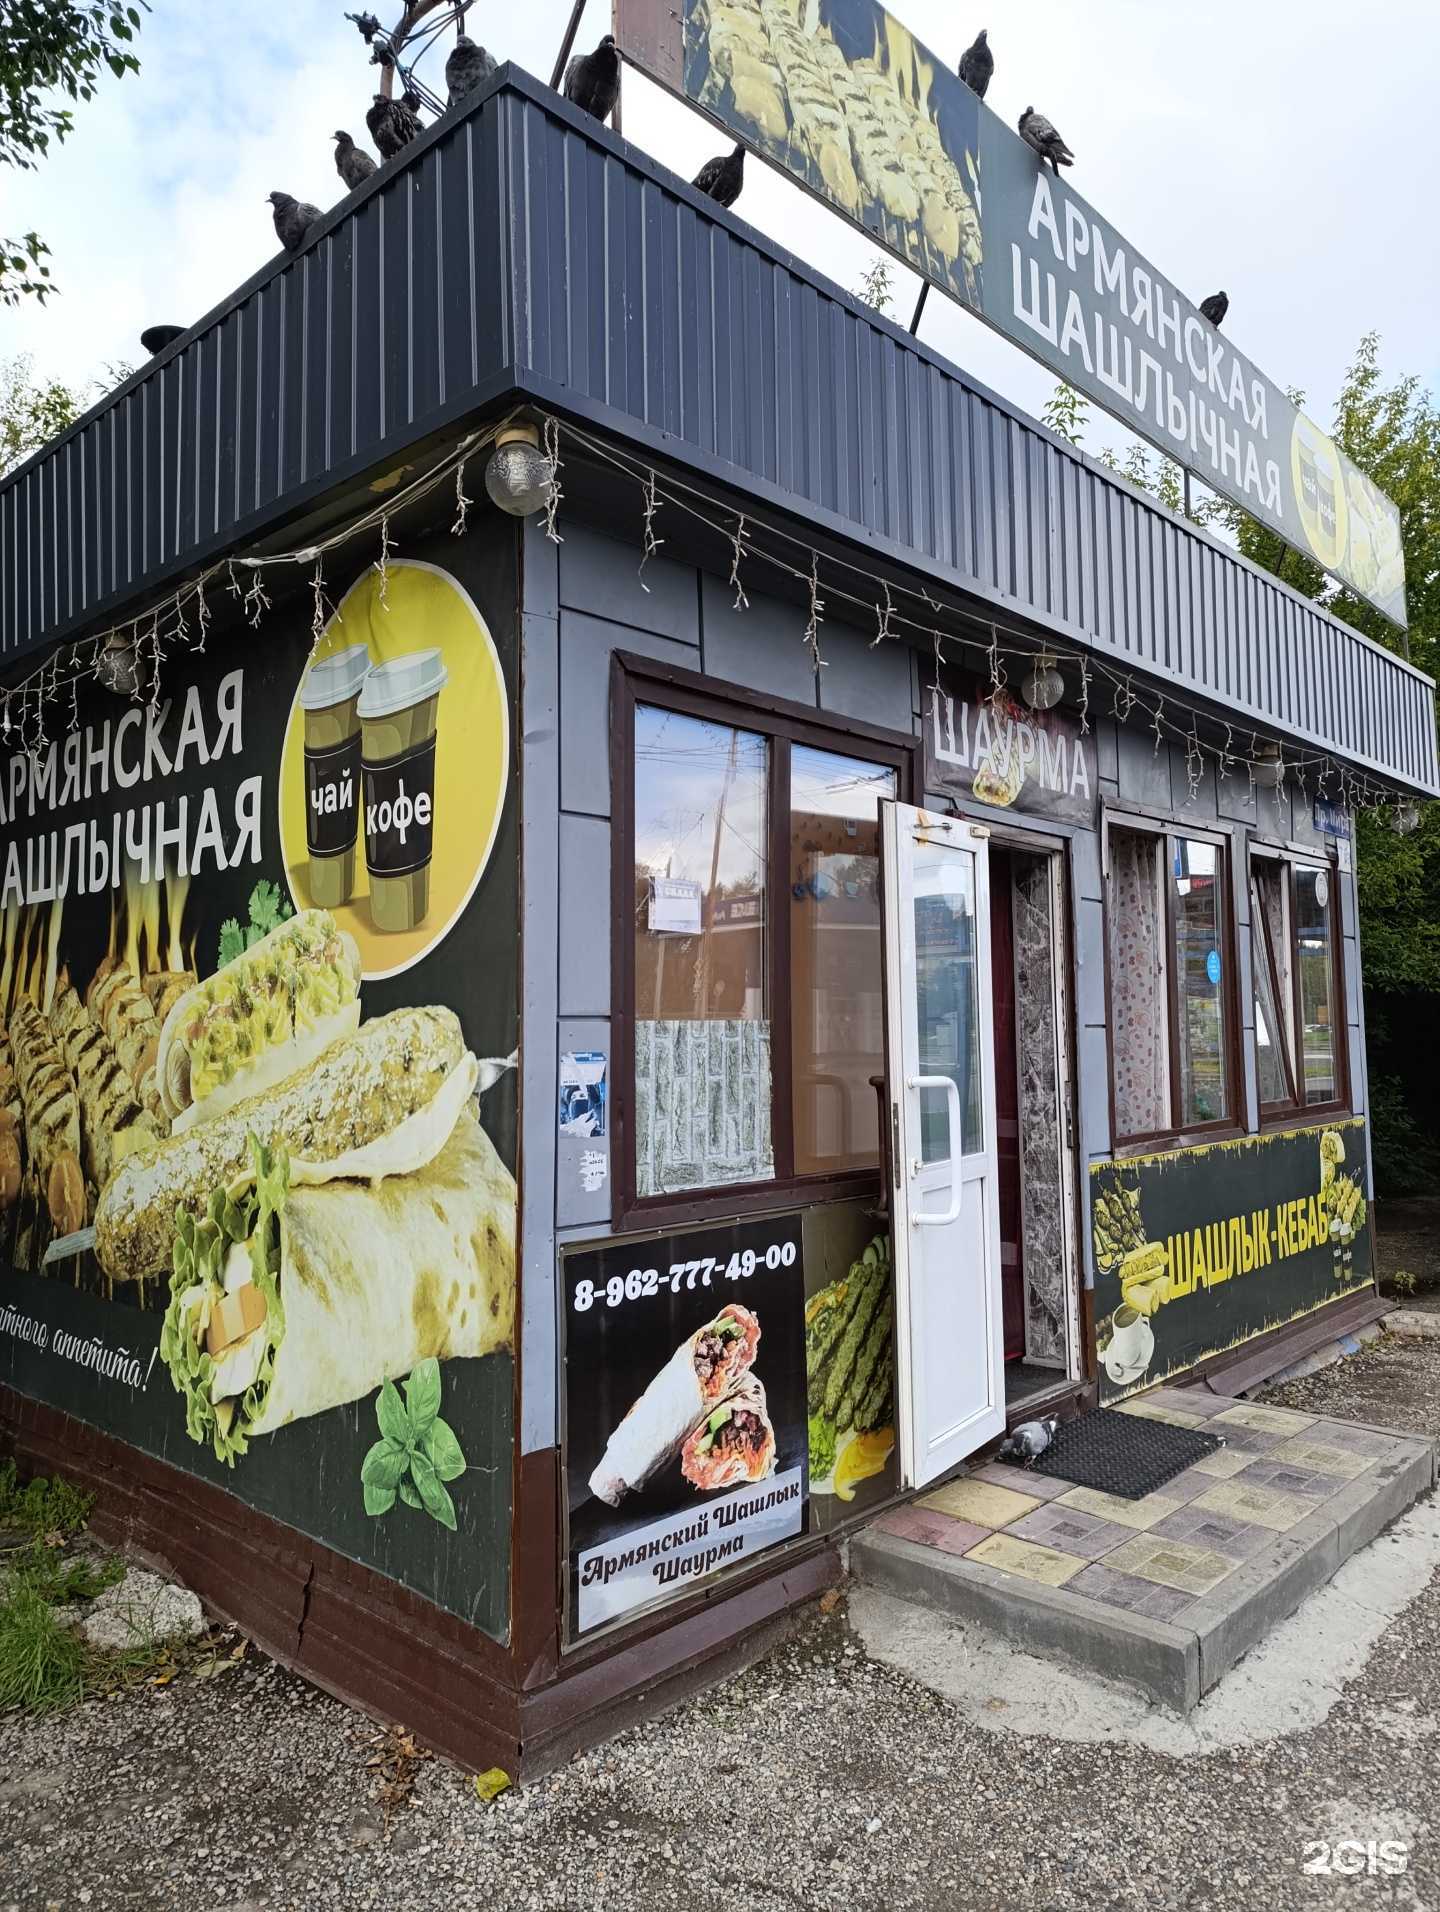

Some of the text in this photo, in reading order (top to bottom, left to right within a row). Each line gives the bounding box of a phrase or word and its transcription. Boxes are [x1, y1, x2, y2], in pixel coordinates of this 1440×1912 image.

[1028, 172, 1268, 438] АРМЯНСКАЯ
[1012, 243, 1282, 517] ШАШЛЫЧНАЯ
[932, 692, 1090, 799] ШАУРМА
[311, 767, 353, 816] чай
[366, 778, 431, 845] кофе
[574, 1242, 796, 1312] 8-962-777-49-00
[1168, 1191, 1329, 1300] ШАШЛЫК-КЕБАБ
[53, 1329, 159, 1392] аппетита!
[581, 1481, 800, 1587] Армянский Шашлык
[652, 1534, 745, 1586] Шаурма
